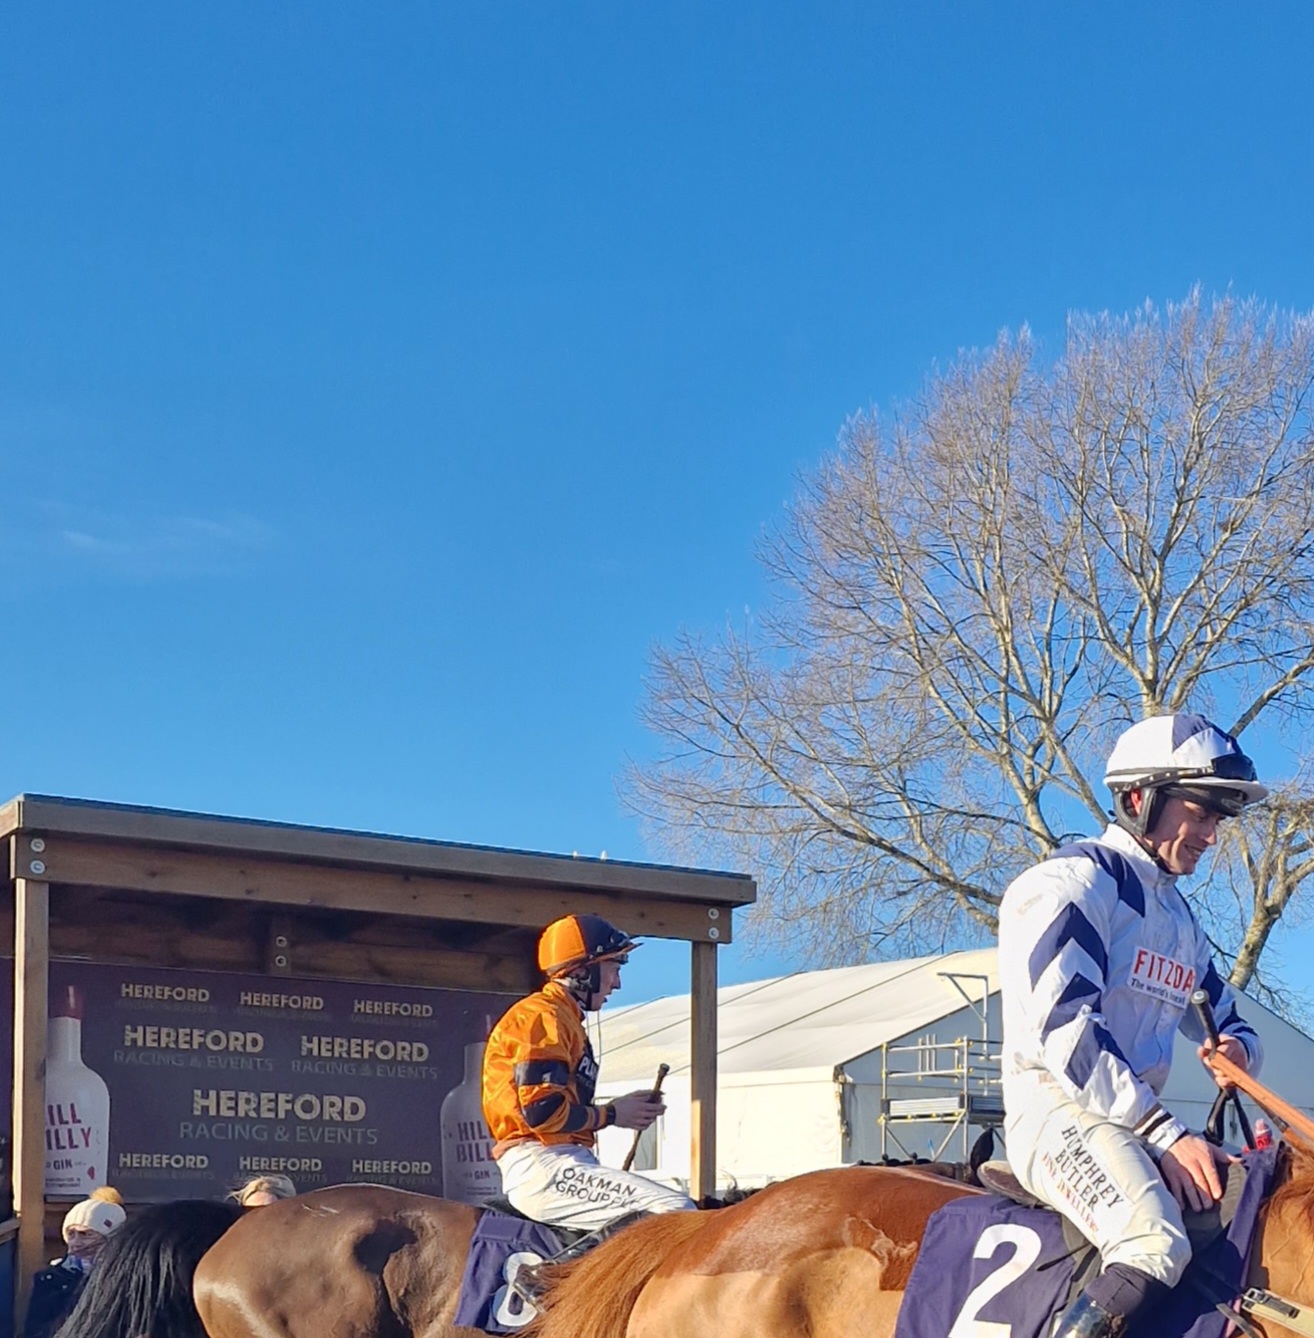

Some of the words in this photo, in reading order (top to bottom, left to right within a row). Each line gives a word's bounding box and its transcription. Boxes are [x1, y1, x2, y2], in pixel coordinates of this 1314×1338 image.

[121, 983, 210, 1002] HEREFORD
[240, 991, 324, 1010] HEREFORD
[353, 999, 433, 1018] HEREFORD
[124, 1024, 265, 1053] HEREFORD
[301, 1035, 429, 1062] HEREFORD
[113, 1050, 185, 1067] RACING
[207, 1055, 274, 1071] EVENTS
[291, 1060, 357, 1076] RACING
[376, 1064, 438, 1079] EVENTS
[46, 1103, 82, 1126] ILL
[193, 1089, 367, 1122] HEREFORD
[45, 1126, 92, 1151] ILLY
[179, 1122, 269, 1141] RACING
[274, 1127, 290, 1142] &
[295, 1126, 378, 1145] EVENTS
[457, 1120, 494, 1141] HIL
[119, 1153, 209, 1169] HEREFORD
[456, 1142, 497, 1162] BILL
[53, 1159, 73, 1170] GIN
[239, 1156, 323, 1172] HEREFORD
[352, 1159, 432, 1174] HEREFORD
[1061, 1125, 1124, 1208] HUMPHREY
[288, 1173, 328, 1183] VENTS
[562, 1168, 637, 1196] OAKMAN
[1055, 1148, 1099, 1213] BUTLER
[556, 1180, 611, 1203] GROUP
